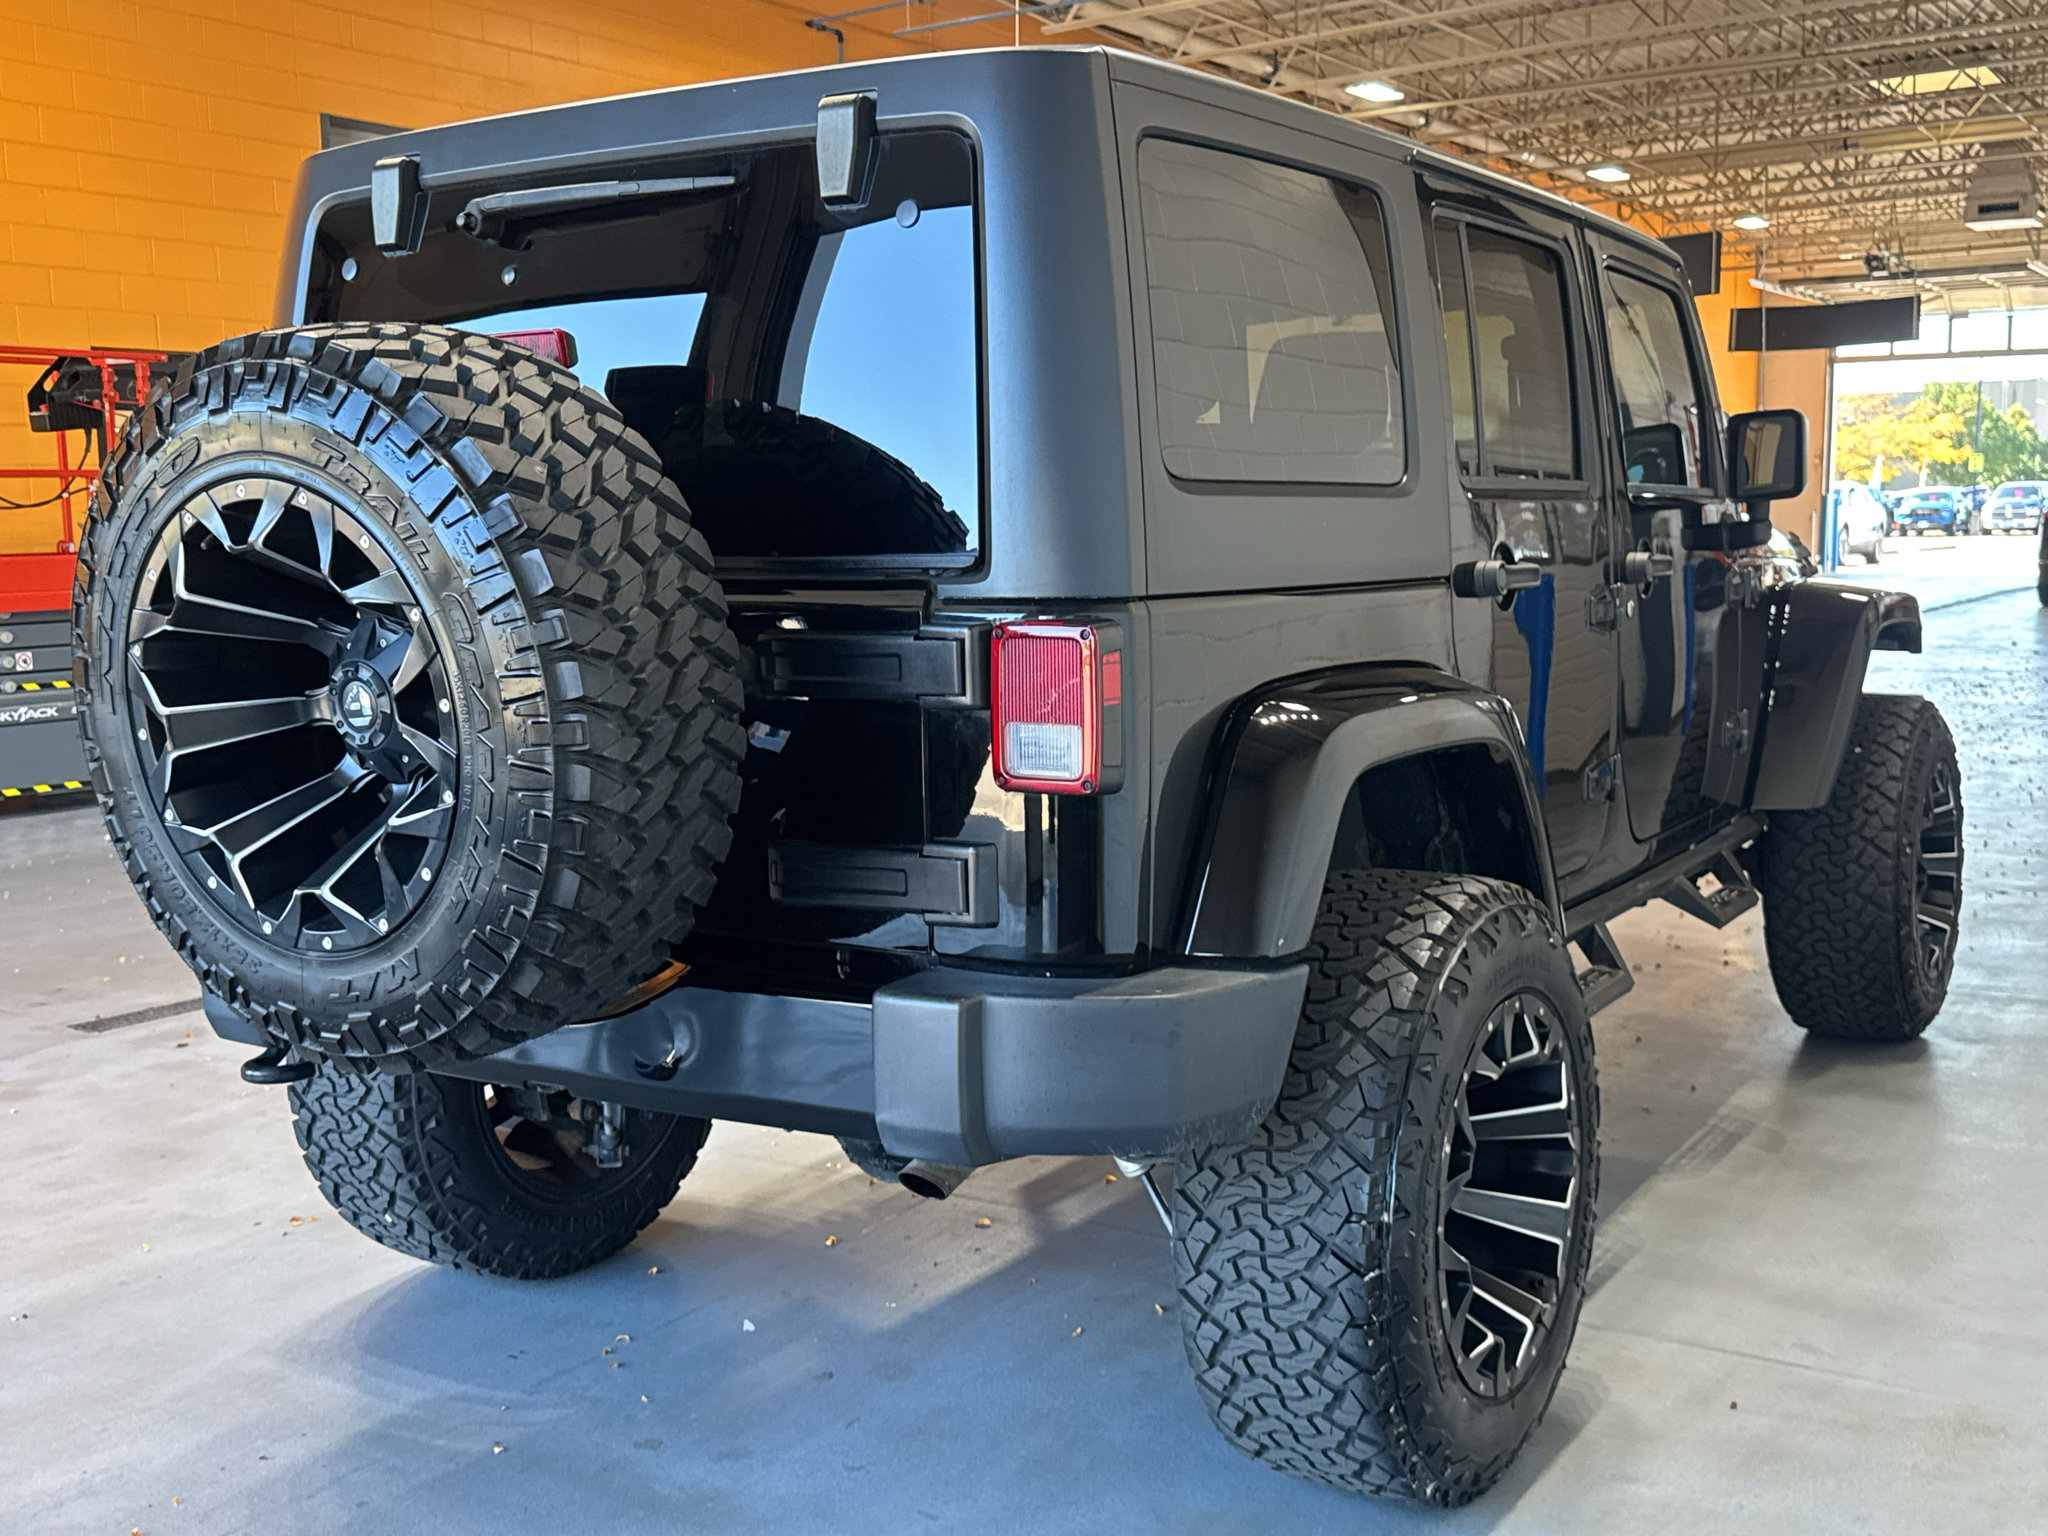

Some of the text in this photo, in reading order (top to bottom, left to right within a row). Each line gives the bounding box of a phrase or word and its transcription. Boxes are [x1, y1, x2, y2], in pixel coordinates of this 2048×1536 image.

[0, 706, 59, 722] KYJACK
[311, 437, 430, 571] TRAIL
[440, 591, 495, 924] GRAPPLER
